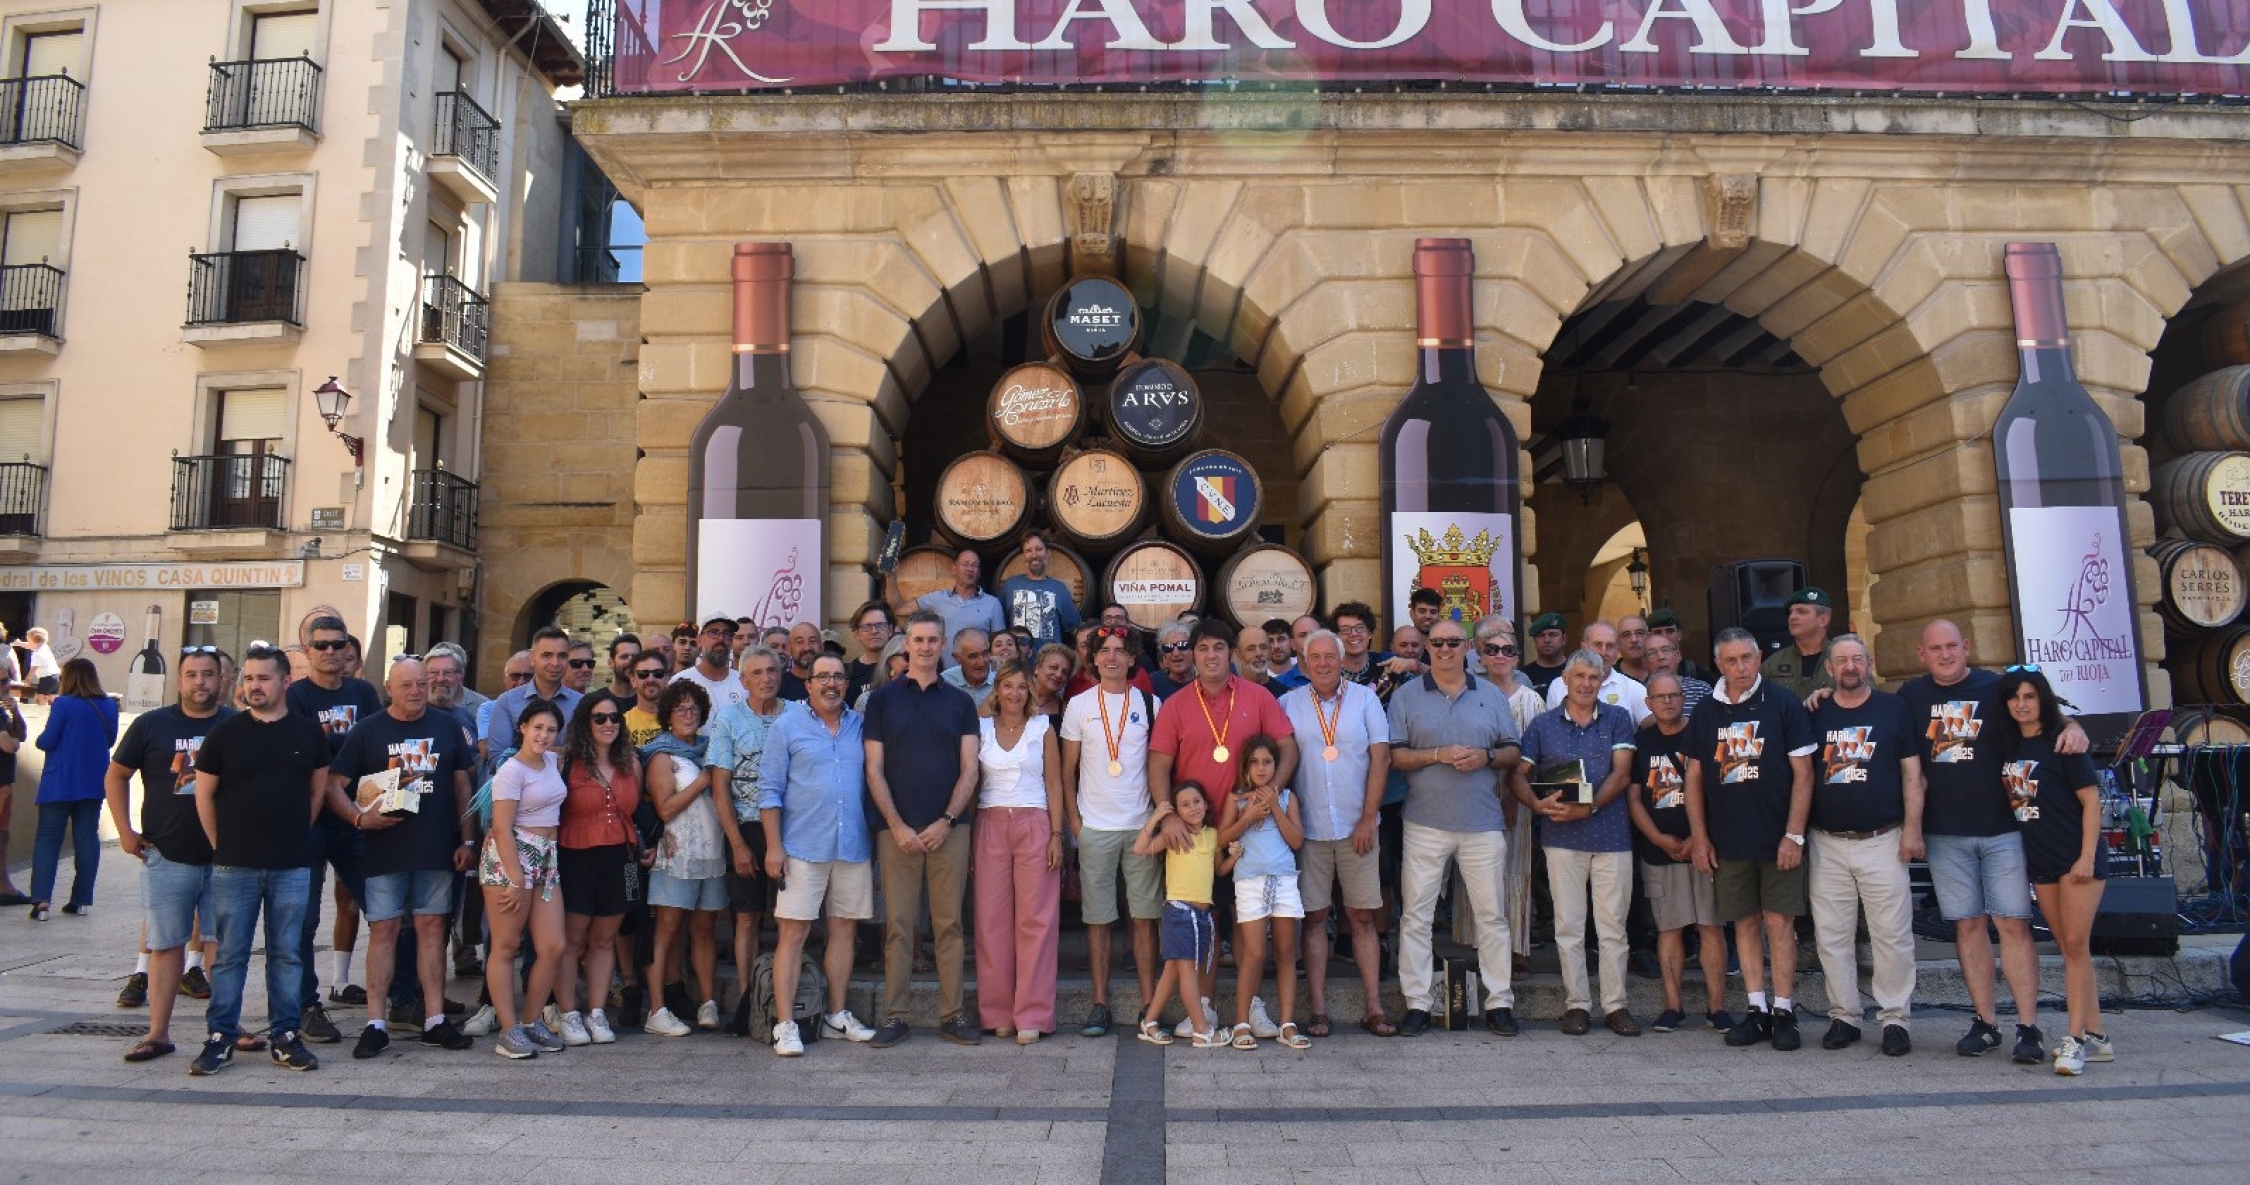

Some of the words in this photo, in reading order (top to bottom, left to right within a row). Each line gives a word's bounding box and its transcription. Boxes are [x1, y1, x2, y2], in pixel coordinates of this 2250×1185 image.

[1070, 315, 1121, 324] MASET
[2219, 490, 2250, 506] TERE
[2228, 508, 2250, 517] HAR
[0, 570, 33, 588] dral
[39, 570, 58, 588] de
[64, 569, 88, 587] los
[93, 569, 148, 587] VINOS
[157, 567, 205, 585] CASA
[2180, 569, 2231, 581] CARLOS
[1119, 581, 1147, 592] VIÑA
[1149, 583, 1192, 592] POMAL
[2180, 581, 2231, 593] SERRES
[2026, 638, 2074, 663] HARO
[2074, 634, 2133, 662] CAPITAL
[2076, 664, 2111, 684] RIOJA
[1930, 703, 1955, 718] HARO
[1717, 726, 1739, 740] HARO
[1826, 730, 1850, 742] HARO
[175, 738, 201, 751] HARO
[387, 742, 412, 756] HARO
[1738, 765, 1759, 780] 2025
[1844, 768, 1868, 781] 2025
